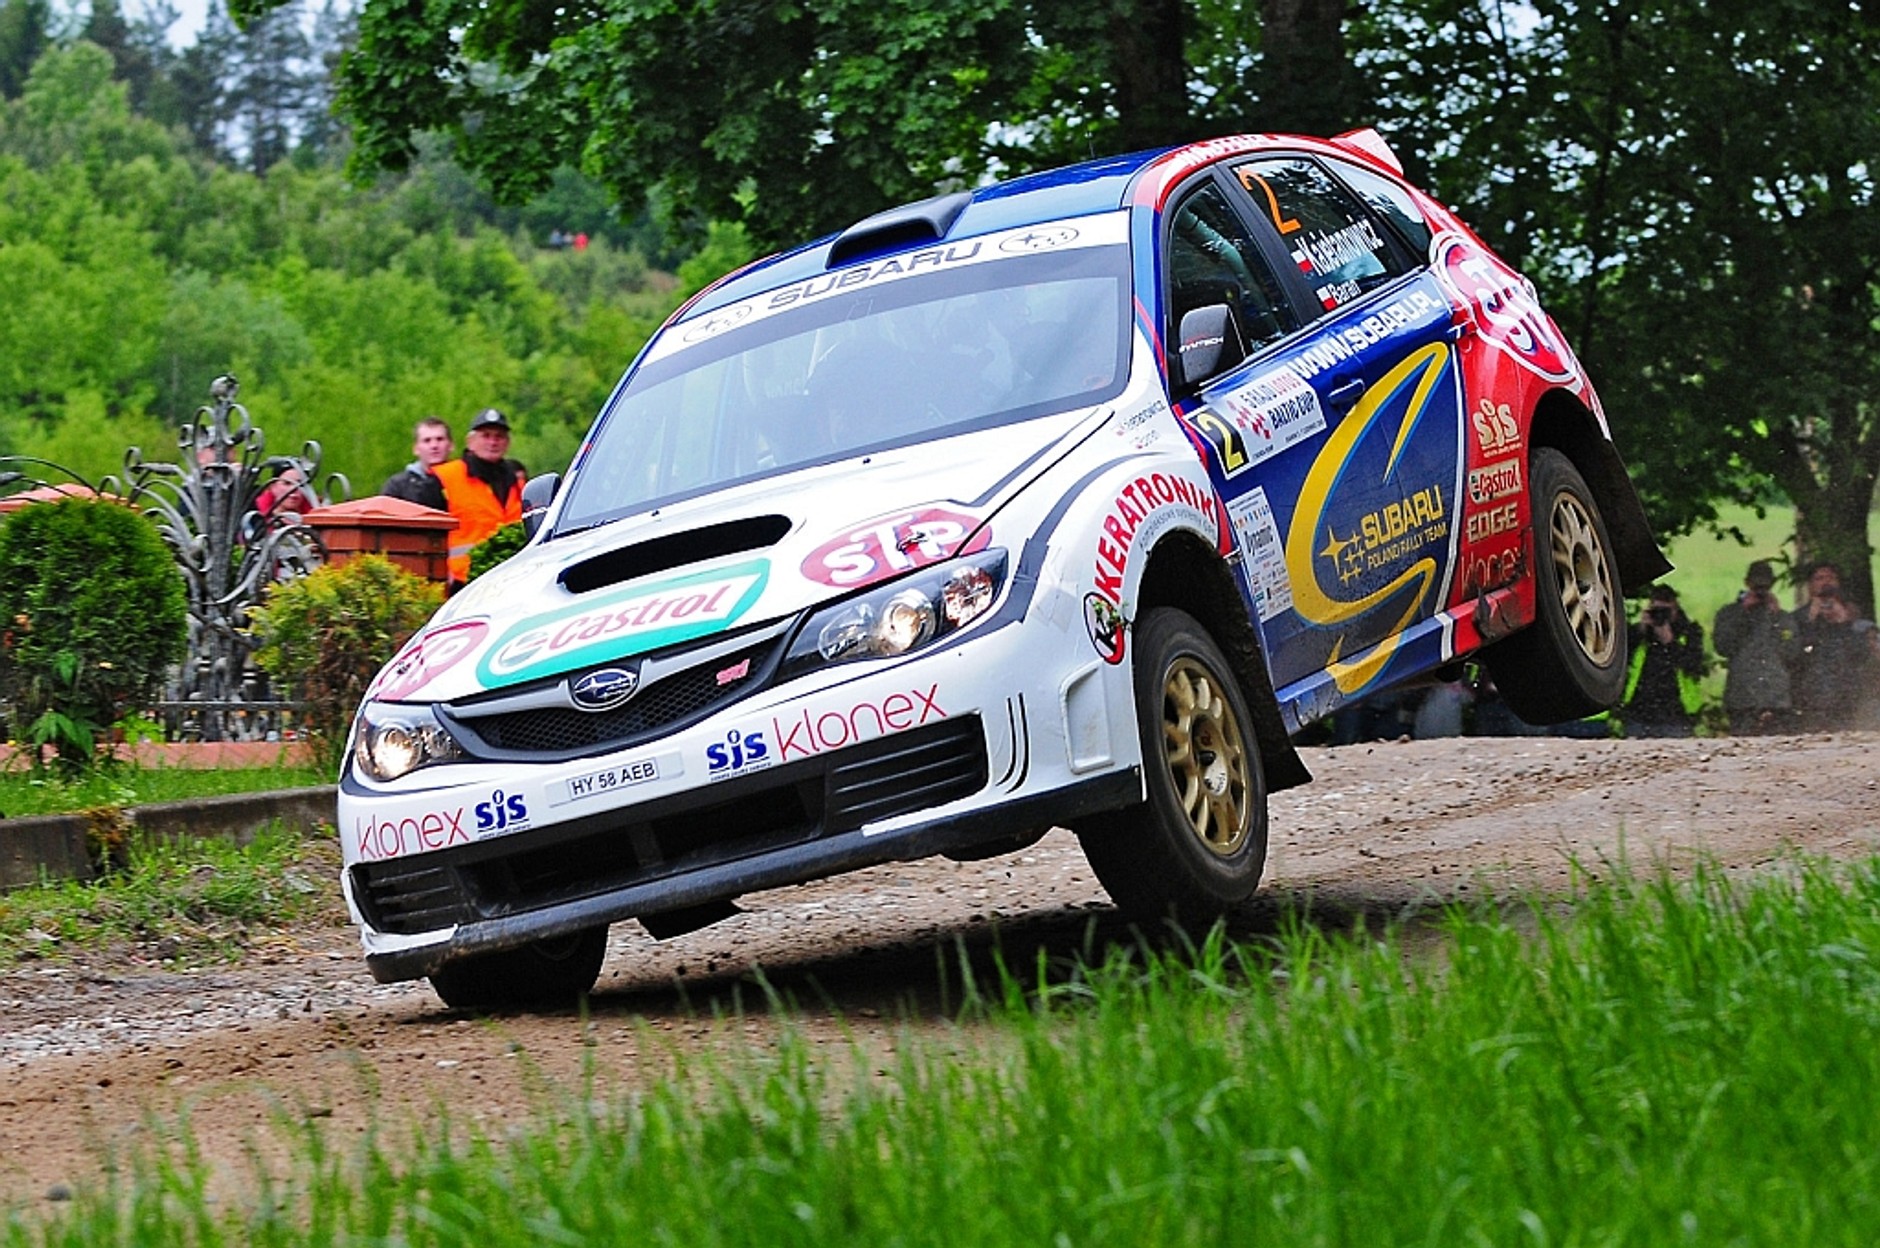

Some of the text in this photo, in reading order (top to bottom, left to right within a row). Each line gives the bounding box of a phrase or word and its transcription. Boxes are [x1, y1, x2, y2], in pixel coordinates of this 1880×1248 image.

[1238, 169, 1301, 235] 2
[767, 242, 982, 310] SUBARU
[1327, 283, 1361, 305] Baran
[1288, 290, 1442, 379] WWW.SUBARU.PL
[1197, 412, 1244, 471] 2
[1479, 463, 1520, 498] Castrol
[823, 513, 968, 585] STP
[1094, 472, 1216, 604] KERATRONIK
[1360, 484, 1444, 550] SUBARU
[1367, 521, 1448, 572] POLAND RALLY TEAM
[1466, 502, 1519, 544] EDGE
[549, 584, 732, 652] Castrol
[706, 683, 948, 770] sjs klonex
[571, 762, 655, 796] HY 58 AEB
[356, 788, 529, 860] klonex sjs
